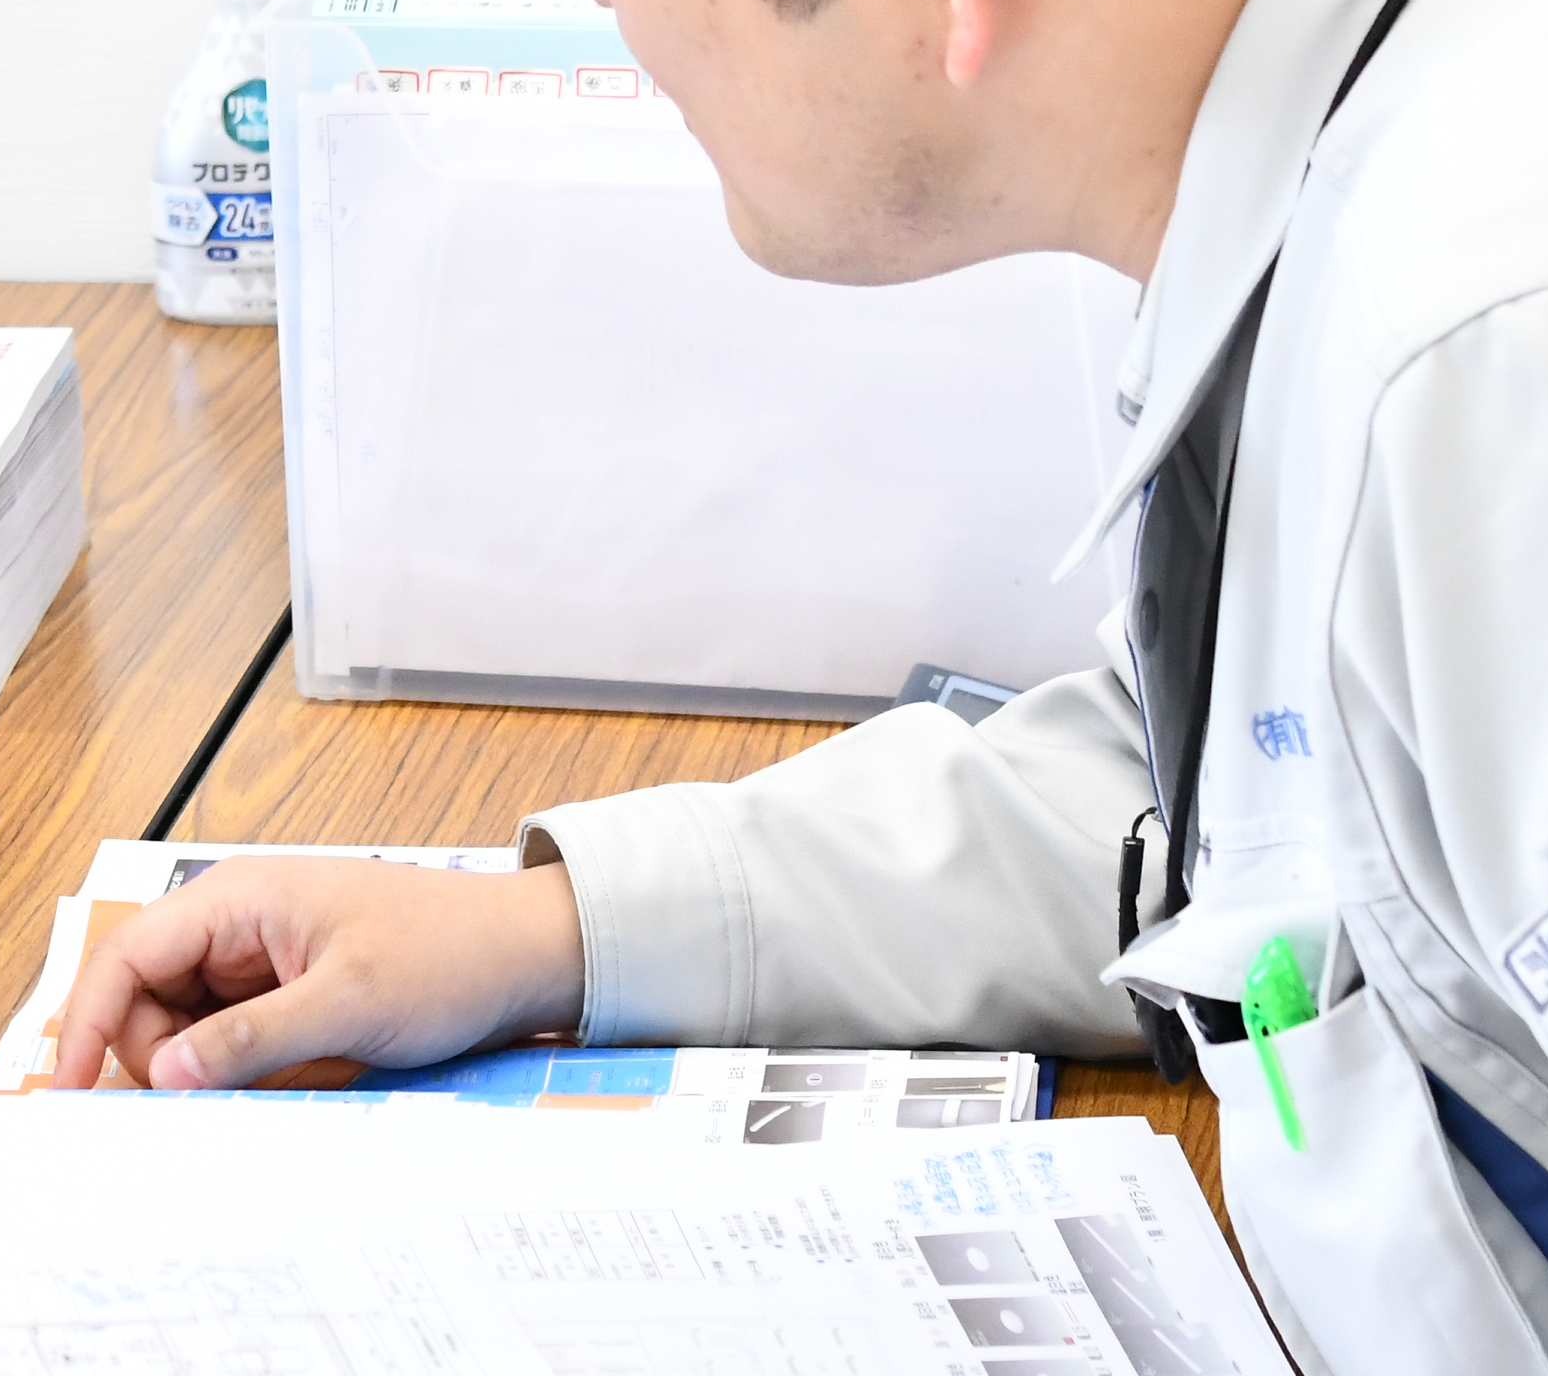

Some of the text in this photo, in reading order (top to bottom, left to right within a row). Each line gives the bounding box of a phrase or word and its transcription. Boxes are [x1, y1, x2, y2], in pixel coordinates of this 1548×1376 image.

[192, 162, 271, 184] プロテク
[224, 201, 256, 234] 24
